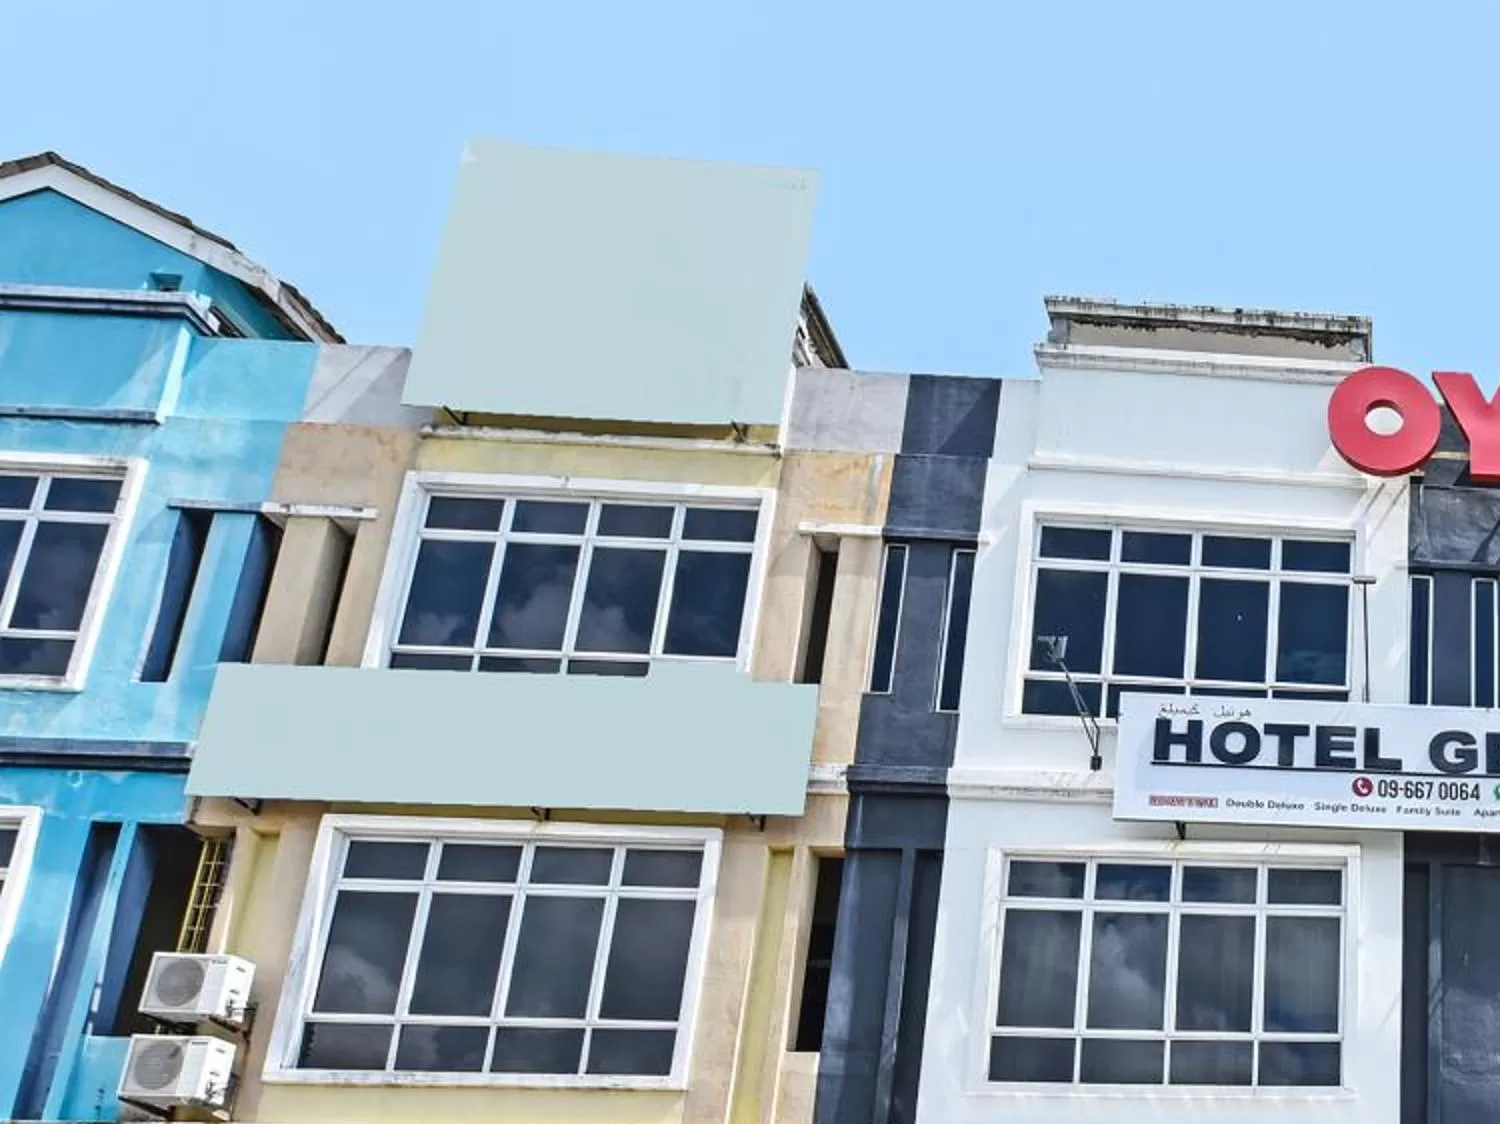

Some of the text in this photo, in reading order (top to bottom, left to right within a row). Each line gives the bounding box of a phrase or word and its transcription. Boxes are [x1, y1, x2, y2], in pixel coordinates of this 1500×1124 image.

[1154, 718, 1403, 770] HOTEL
[1377, 779, 1481, 802] 09-667 0064
[1225, 797, 1265, 809] Double
